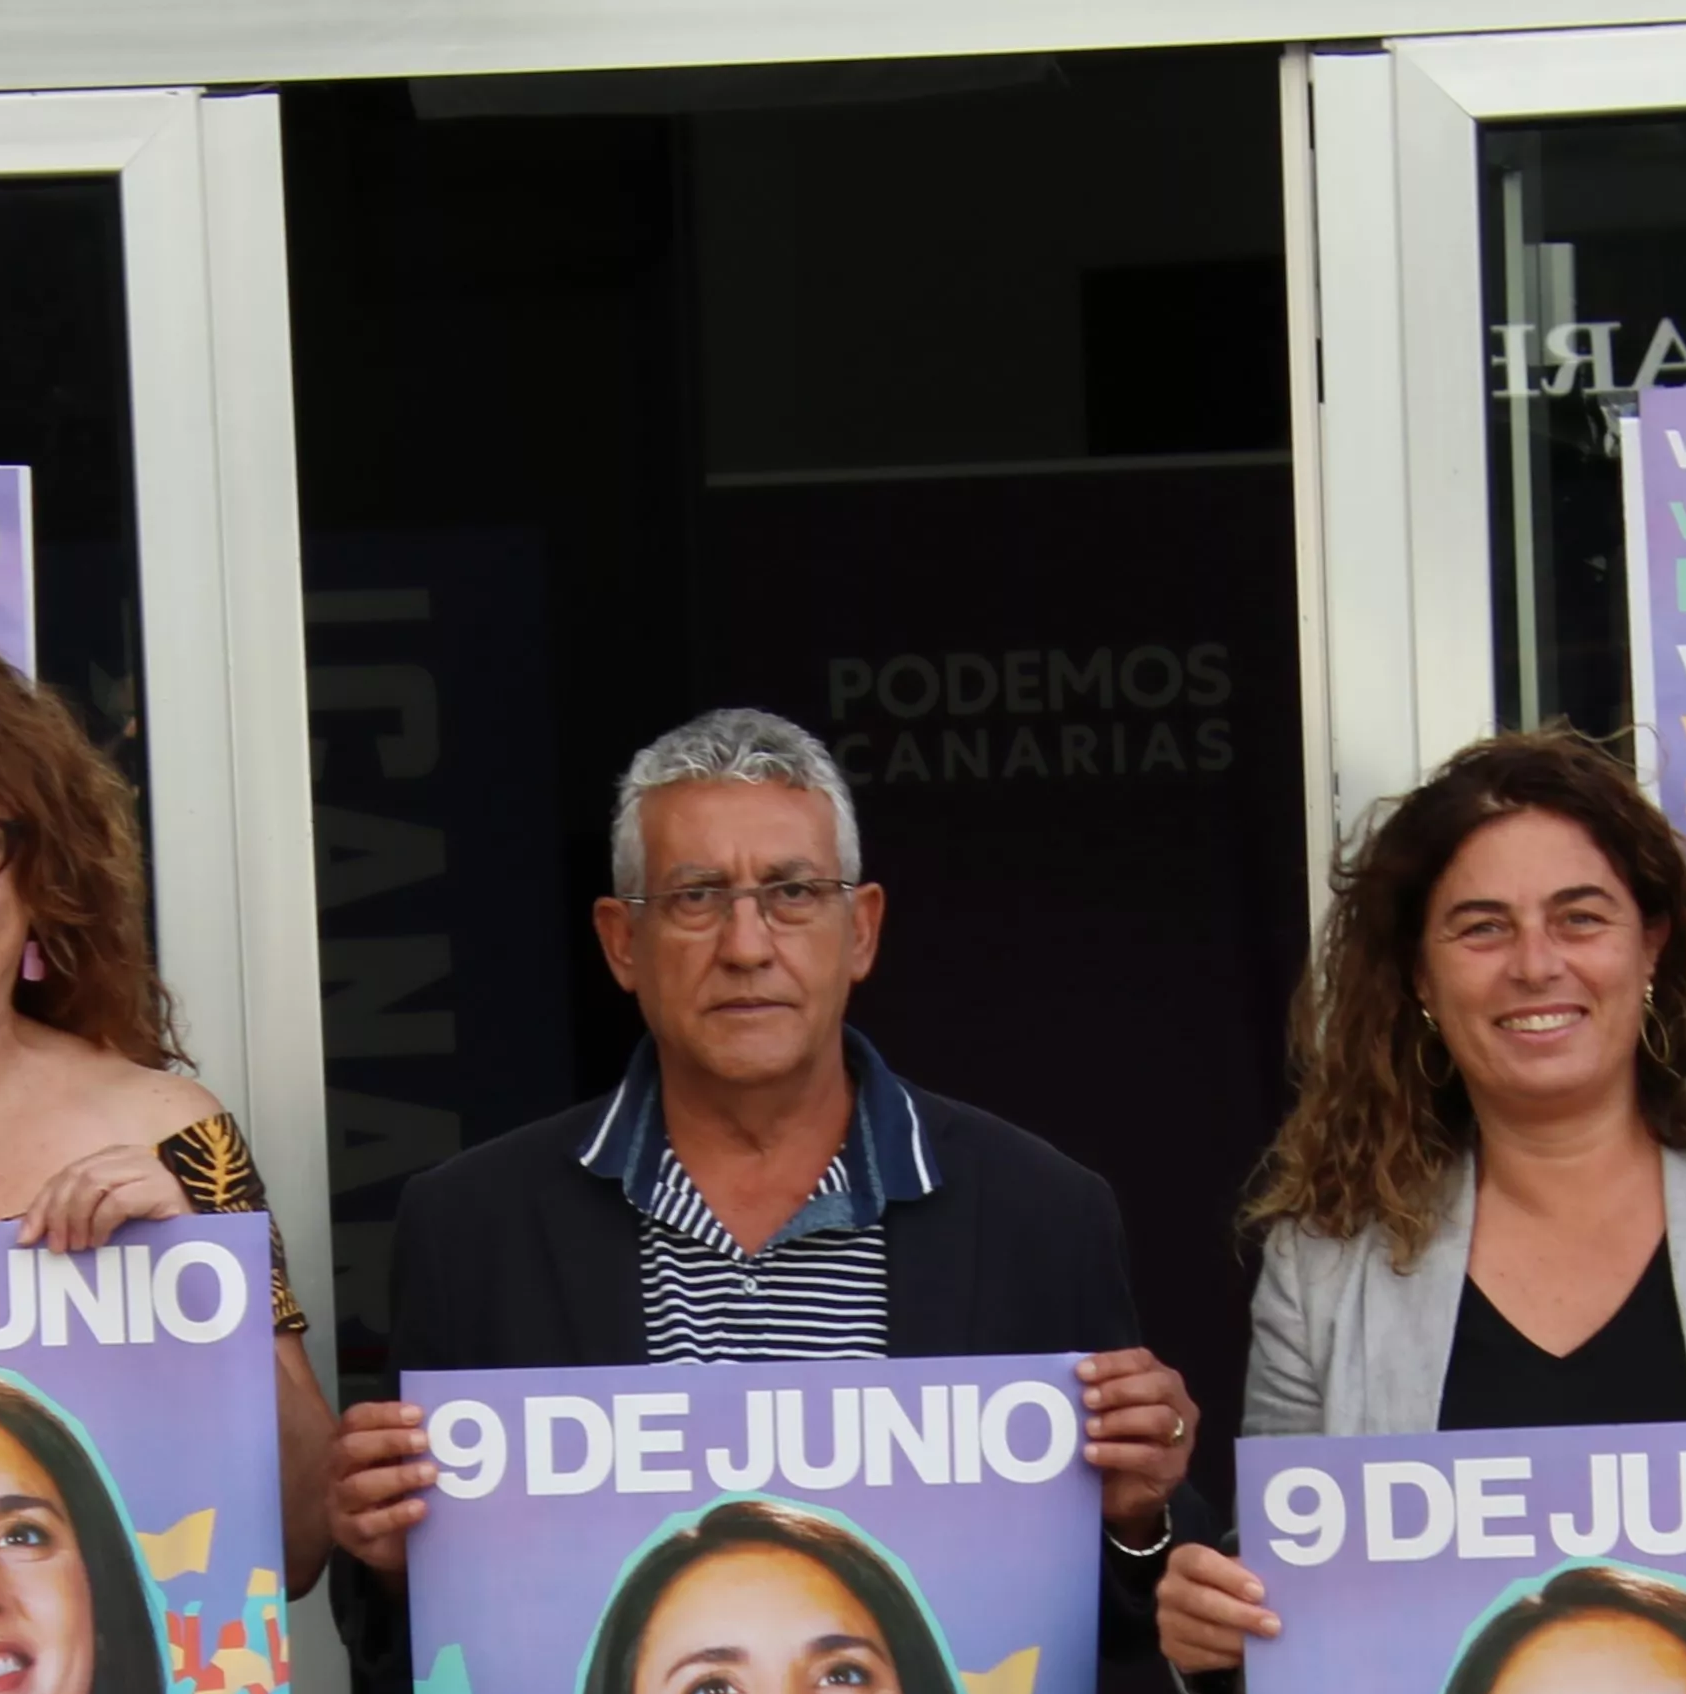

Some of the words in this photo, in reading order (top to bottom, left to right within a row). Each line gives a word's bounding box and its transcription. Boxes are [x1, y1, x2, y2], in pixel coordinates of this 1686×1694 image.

[828, 640, 1233, 720] PODEMOS
[836, 718, 1235, 785] CANARIAS
[427, 1400, 508, 1500] 9
[524, 1392, 693, 1496] DE
[706, 1380, 1079, 1493] JUNIO
[1263, 1467, 1347, 1566] 9
[1363, 1456, 1536, 1562] DE
